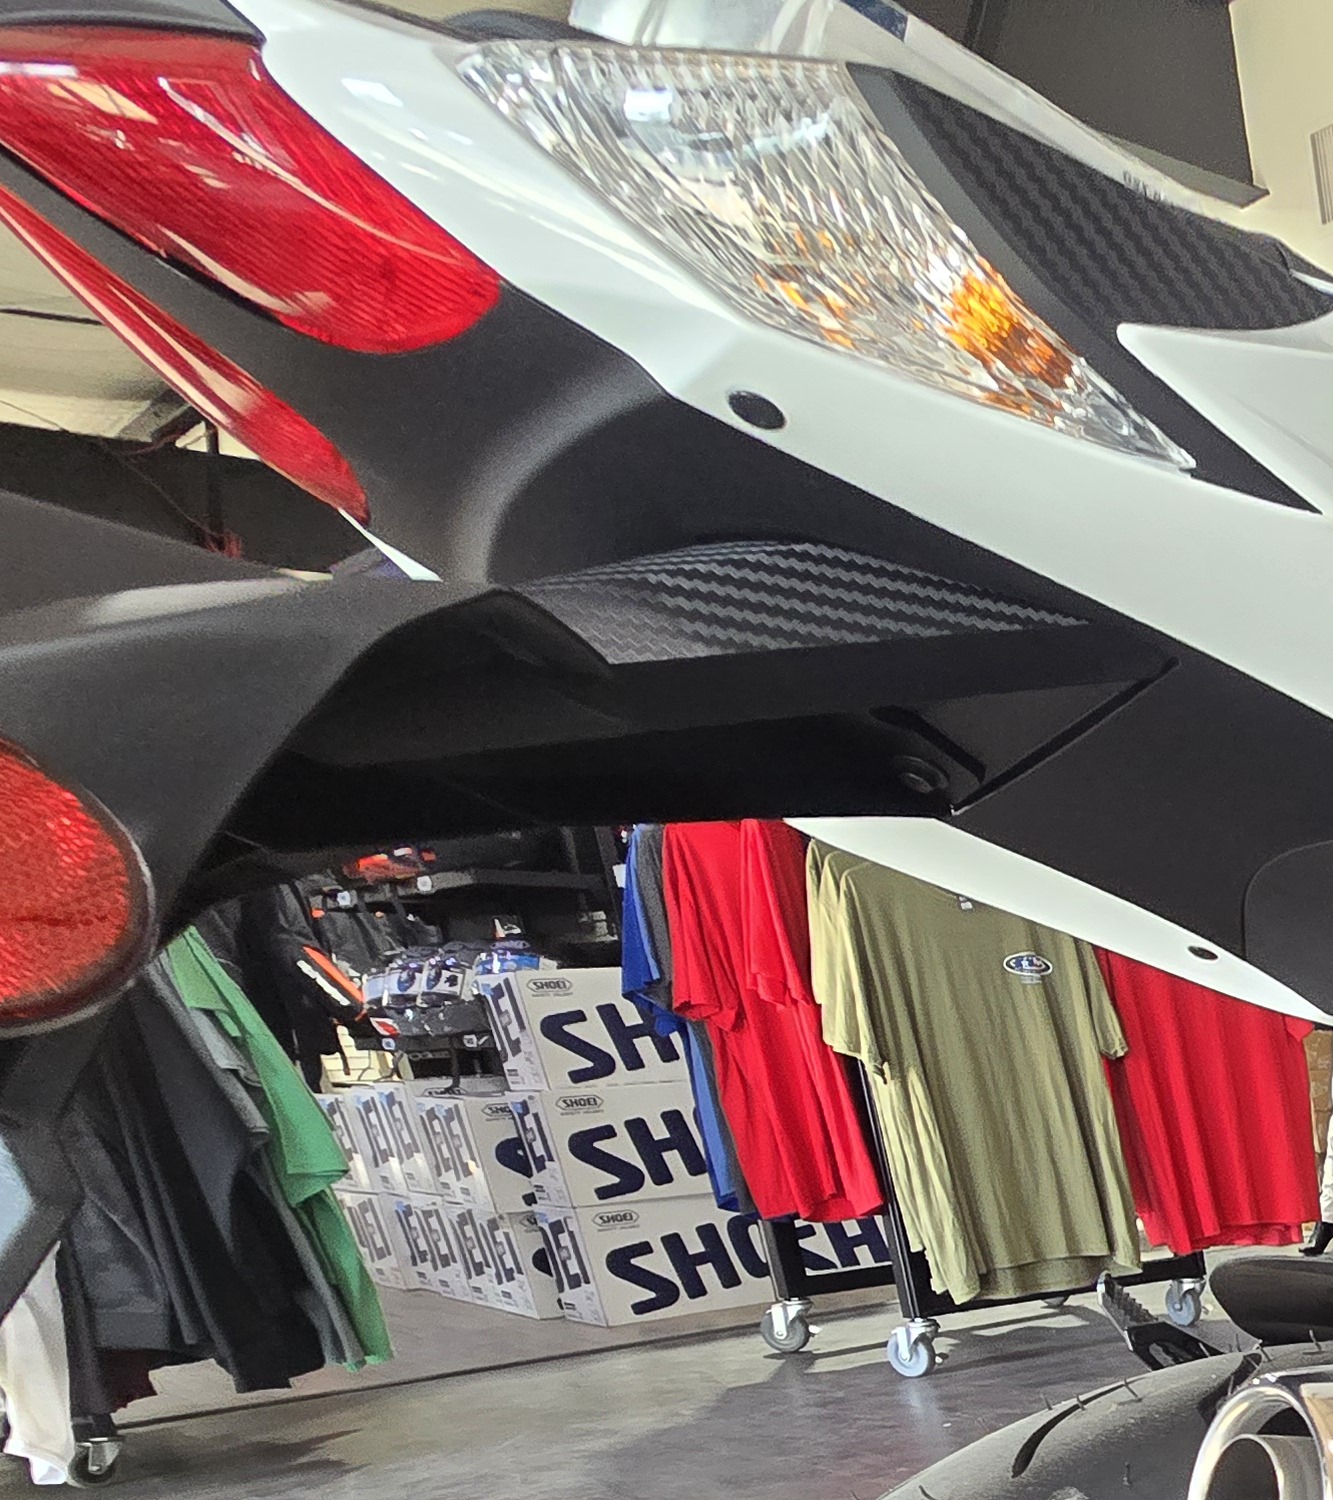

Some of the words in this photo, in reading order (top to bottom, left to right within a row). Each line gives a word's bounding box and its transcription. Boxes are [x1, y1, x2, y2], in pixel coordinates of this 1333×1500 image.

[532, 980, 567, 991] SHOEI
[562, 1097, 598, 1109] SHOEI
[598, 1212, 633, 1225] SHOEI
